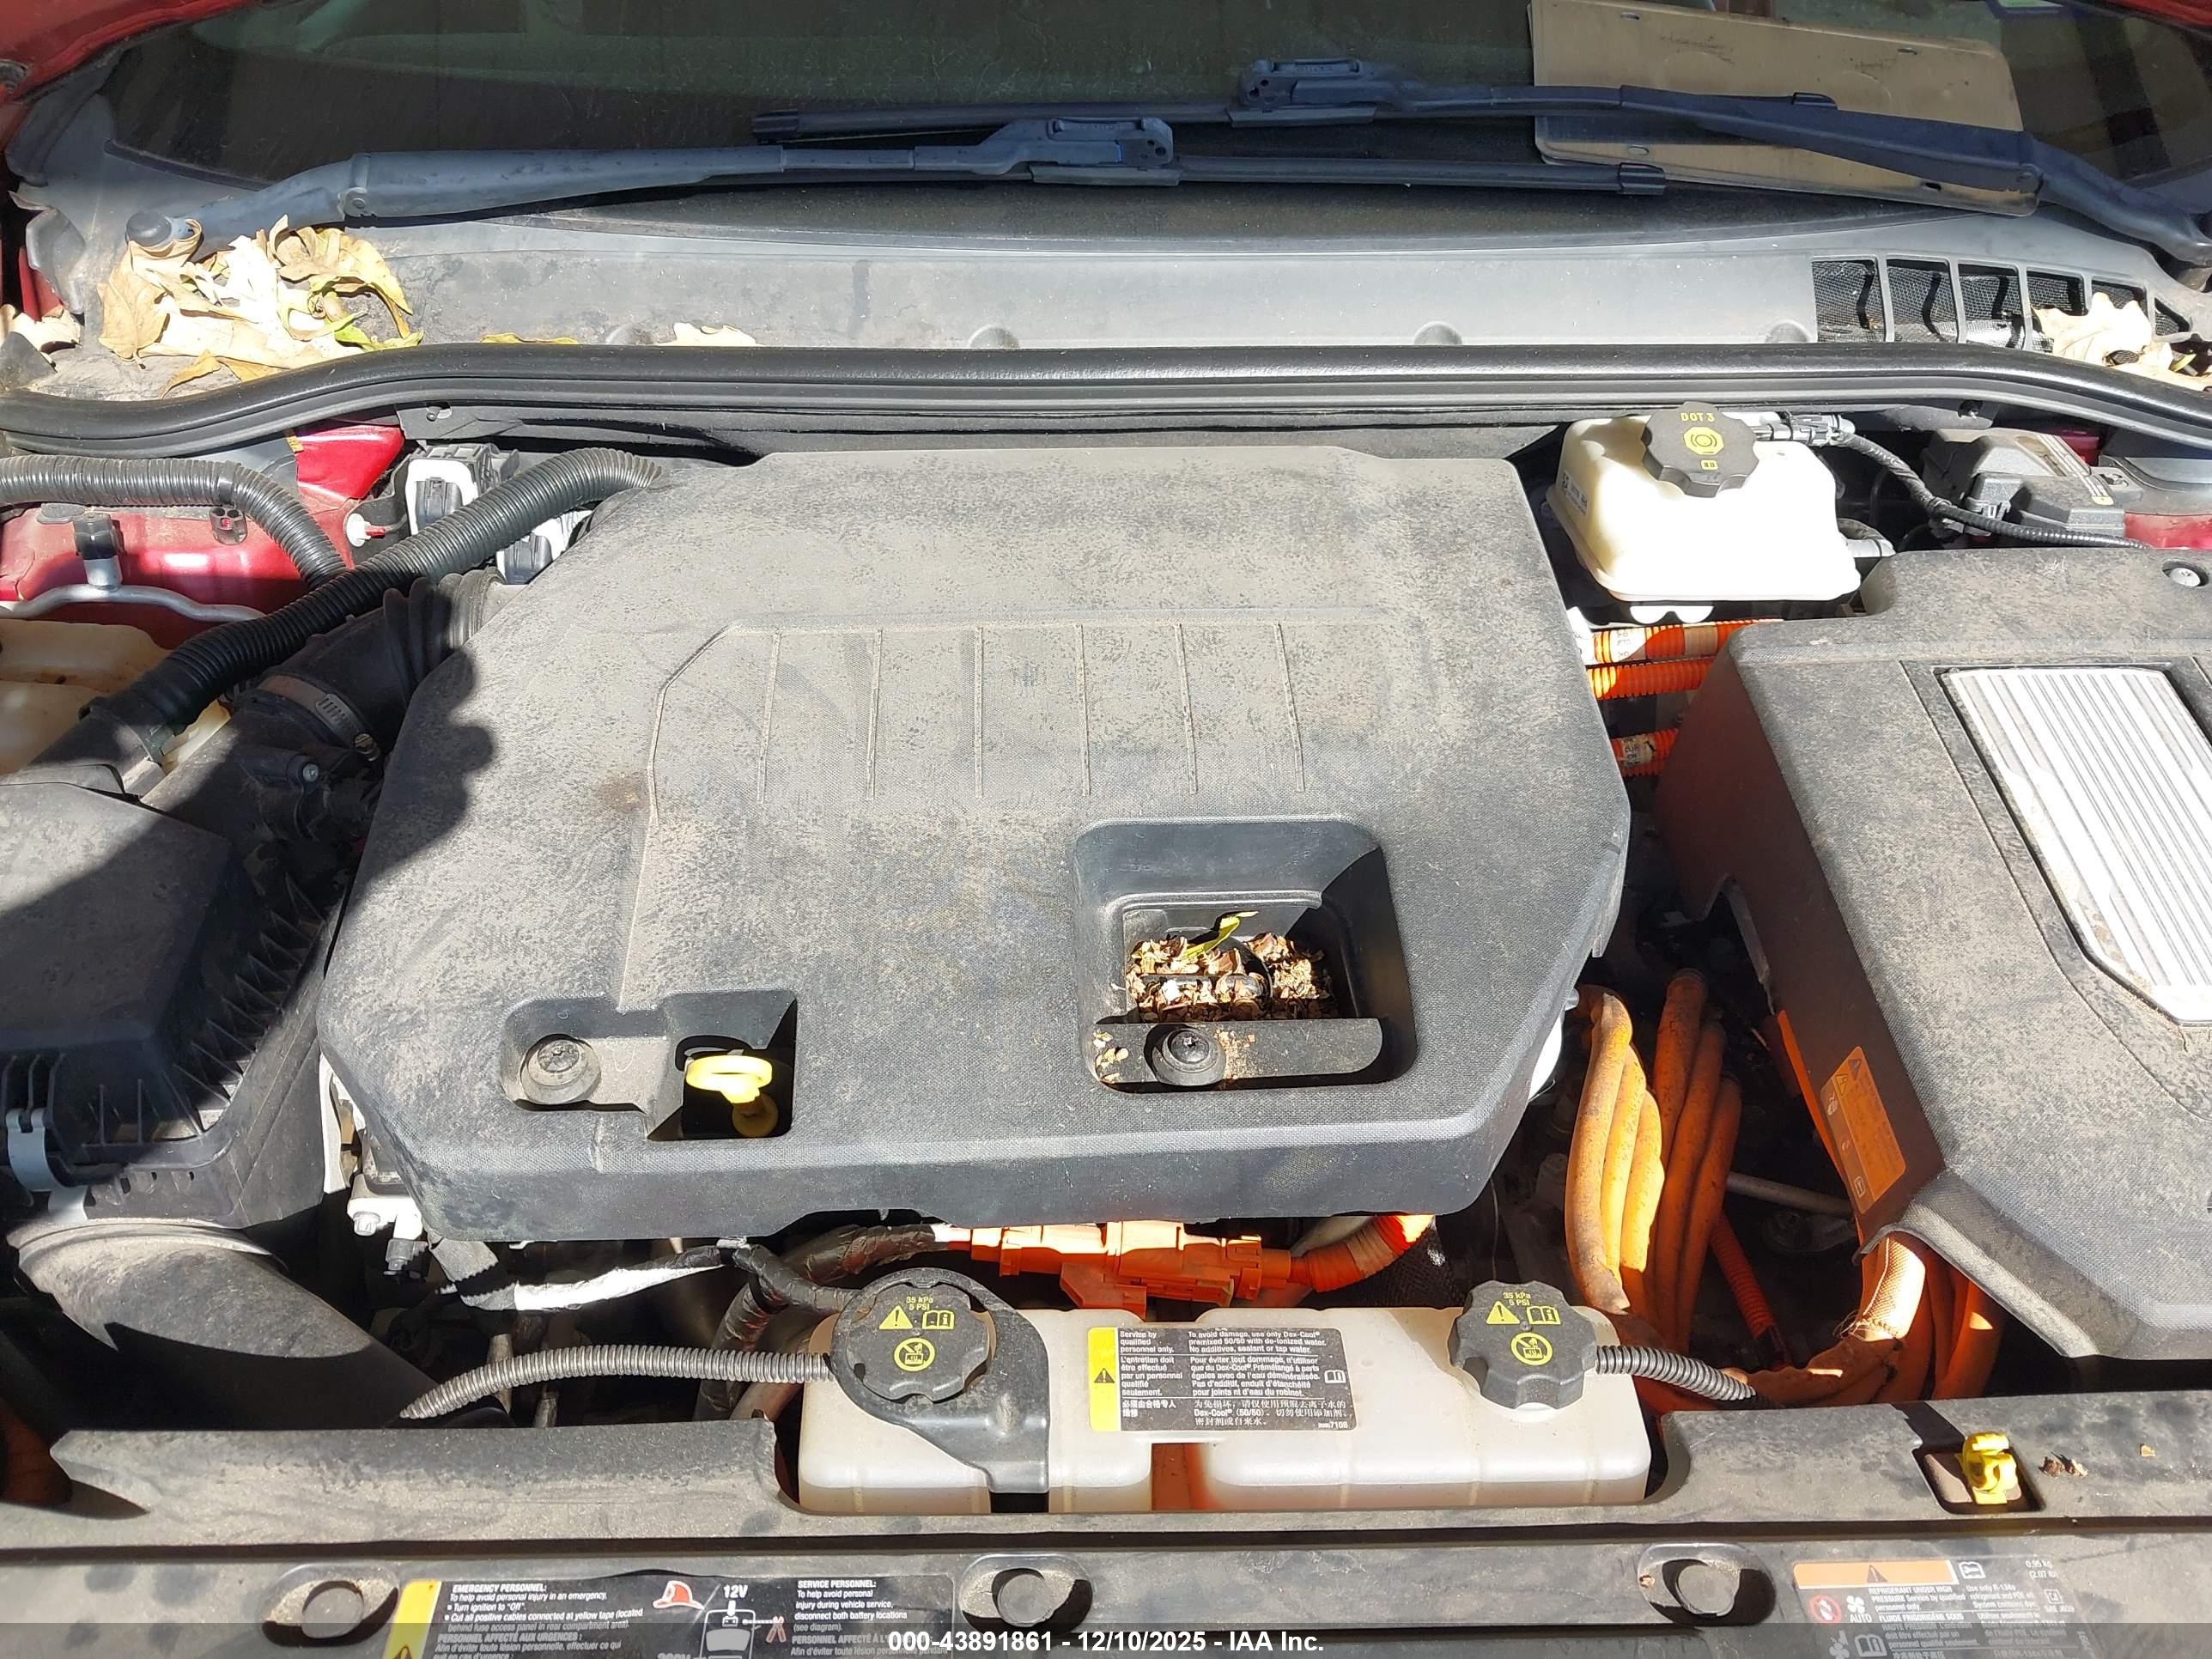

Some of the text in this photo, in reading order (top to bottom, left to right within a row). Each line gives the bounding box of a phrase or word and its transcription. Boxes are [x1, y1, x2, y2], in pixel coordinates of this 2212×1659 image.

[1680, 412, 1715, 422] DOT 3
[918, 1296, 933, 1304] kPa
[1212, 1389, 1232, 1397] joints
[1276, 1389, 1304, 1397] robinet.
[452, 1583, 547, 1593] EMERGENCY PERSONNEL:
[798, 1580, 876, 1589] SERVICE PERSONNEL:
[724, 1584, 748, 1598] 12V
[806, 1589, 822, 1599] help
[823, 1589, 842, 1598] avoid
[843, 1589, 873, 1599] personal
[459, 1593, 476, 1602] help
[476, 1593, 495, 1601] avoid
[496, 1593, 527, 1602] personal
[528, 1593, 548, 1602] injury
[453, 1602, 506, 1613] Turn ignition to
[795, 1601, 816, 1610] injury
[817, 1601, 839, 1610] during
[866, 1601, 894, 1609] service,
[474, 1613, 502, 1622] positive
[503, 1613, 526, 1621] cables
[527, 1612, 565, 1621] connected
[574, 1611, 598, 1621] yellow
[599, 1611, 615, 1620] tape
[616, 1608, 643, 1619] (located
[794, 1611, 908, 1621] disconnect both battery locations
[1850, 1614, 1872, 1623] AUTO
[447, 1623, 473, 1632] behind
[473, 1623, 489, 1632] fuse
[490, 1623, 515, 1632] access
[516, 1622, 538, 1632] panel
[538, 1622, 546, 1631] in
[546, 1622, 562, 1631] rear
[562, 1620, 610, 1632] compartment
[793, 1623, 842, 1633] (see diagram).
[436, 1633, 483, 1644] PERSONNEL
[519, 1632, 536, 1642] AUX
[792, 1635, 836, 1644] PERSONNEL
[790, 1647, 805, 1656] Afin
[835, 1647, 853, 1656] toute
